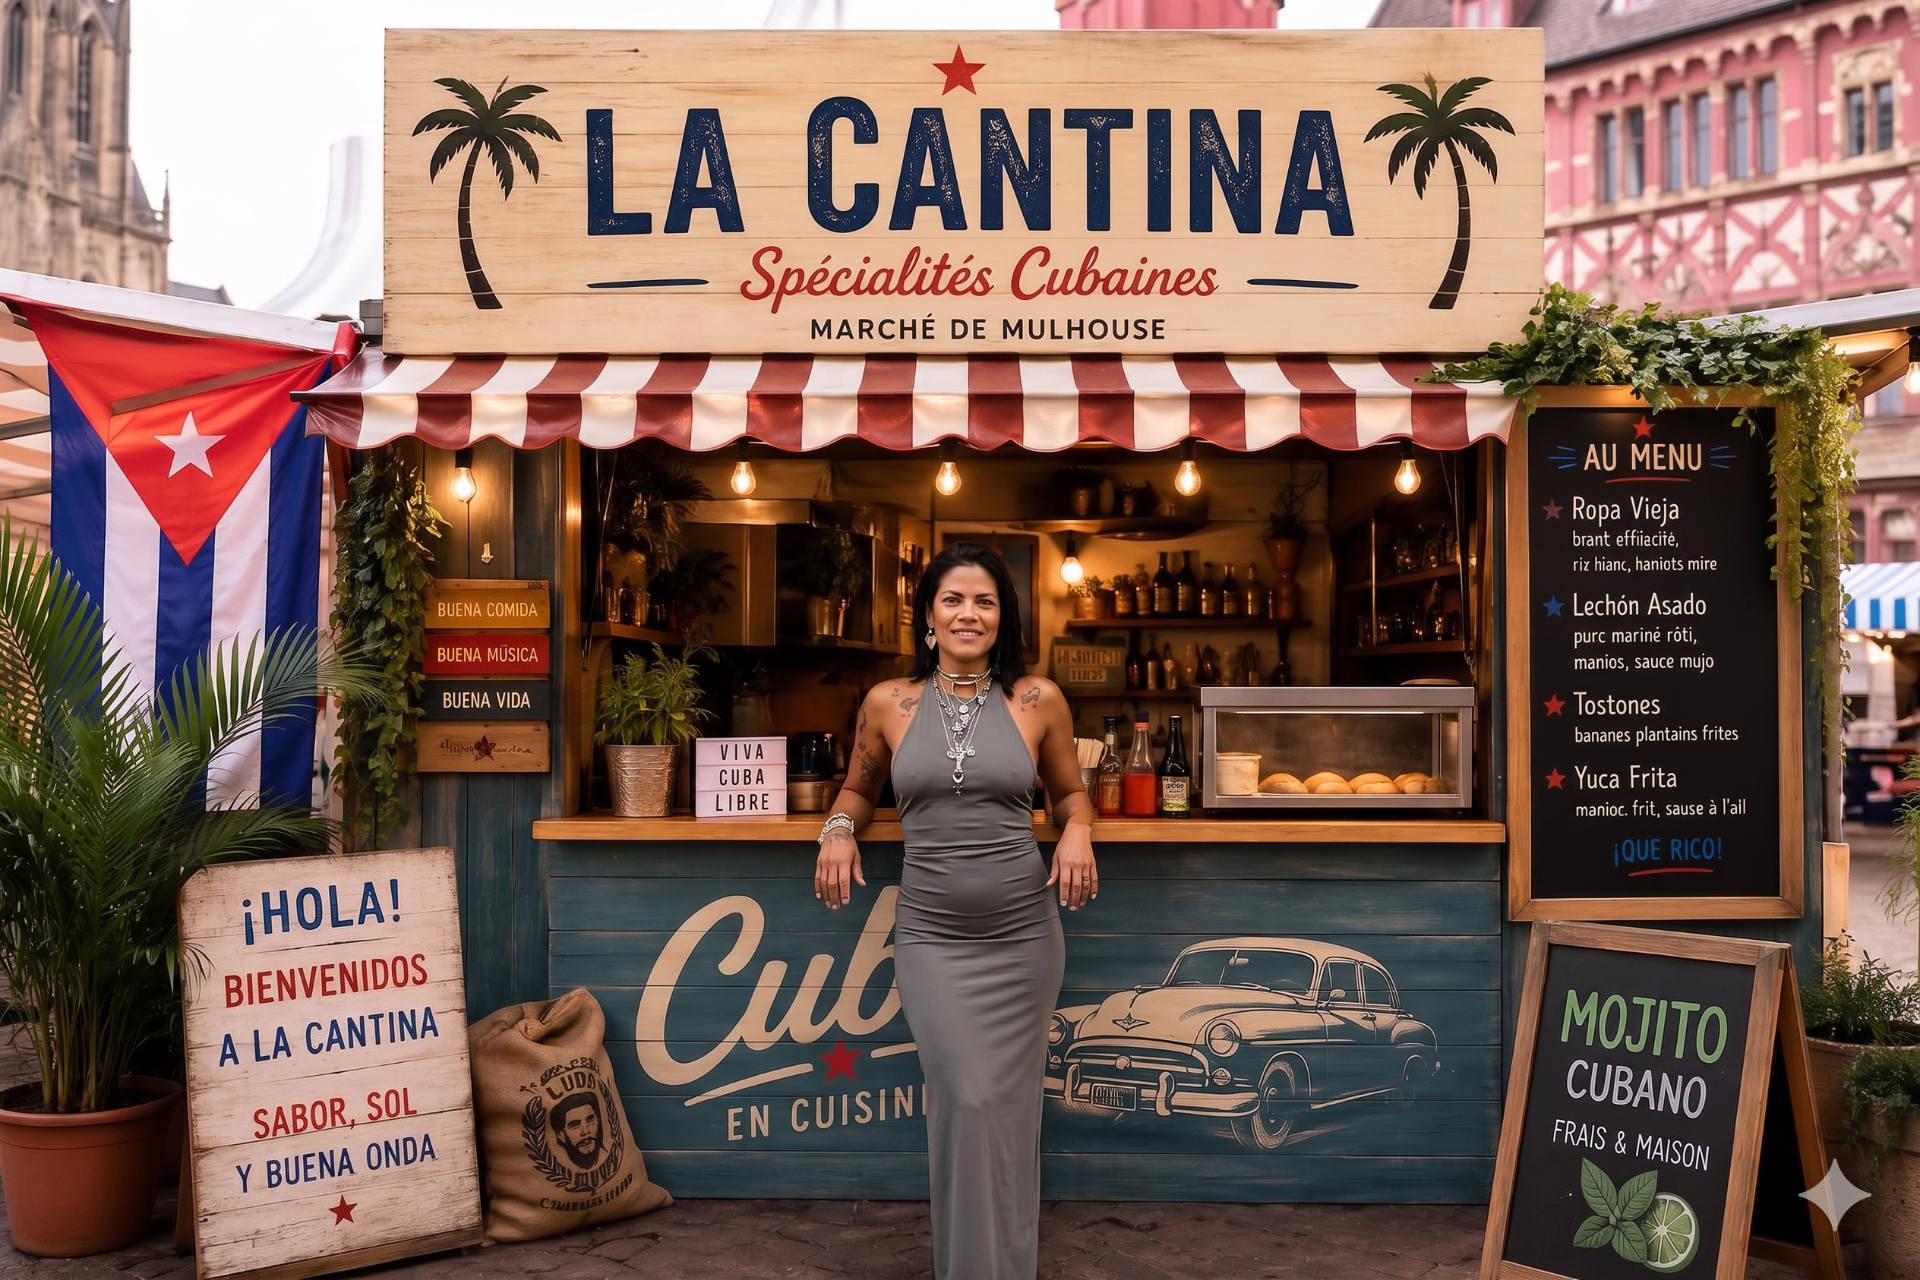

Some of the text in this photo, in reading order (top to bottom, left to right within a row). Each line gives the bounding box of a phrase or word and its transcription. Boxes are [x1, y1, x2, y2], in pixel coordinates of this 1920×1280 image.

[586, 96, 1355, 236] LA CANTINA
[740, 246, 1219, 315] Spécialités Cubaines
[810, 314, 1166, 341] MARCHÉ DE MULHOUSE
[1584, 443, 1702, 471] AU MENU
[1572, 496, 1679, 527] Ropa Vieja
[1572, 530, 1610, 547] brant
[1688, 556, 1718, 571] mire
[438, 602, 538, 617] BUENA COMIDA
[1573, 593, 1707, 617] Lechón Asado
[1574, 626, 1697, 649] purc mariné rôti,
[437, 647, 482, 663] BUENA
[1574, 653, 1714, 674] manios, sauce mujo
[443, 692, 531, 709] BUENA VIDA
[1573, 692, 1661, 716] Tostones
[1574, 724, 1739, 747] bananes plantains frites
[720, 744, 764, 761] VIVA
[719, 768, 765, 786] CUBA
[1574, 765, 1677, 790] Yuca Frita
[715, 793, 770, 812] LIBRE
[1576, 798, 1746, 818] manioc. frit, sause à l'ail
[1614, 837, 1723, 867] ¡QUE RICO!
[242, 879, 400, 945] ¡HOLA!
[224, 953, 429, 1008] BIENVENIDOS
[219, 1006, 439, 1067] A LA CANTINA
[1560, 989, 1728, 1064] MOJITO
[1566, 1059, 1706, 1119] CUBANO
[253, 1087, 418, 1139] SABOR, SOL
[727, 1104, 769, 1140] EN
[1552, 1119, 1710, 1171] FRAIS & MAISON
[235, 1133, 437, 1194] Y BUENA ONDA
